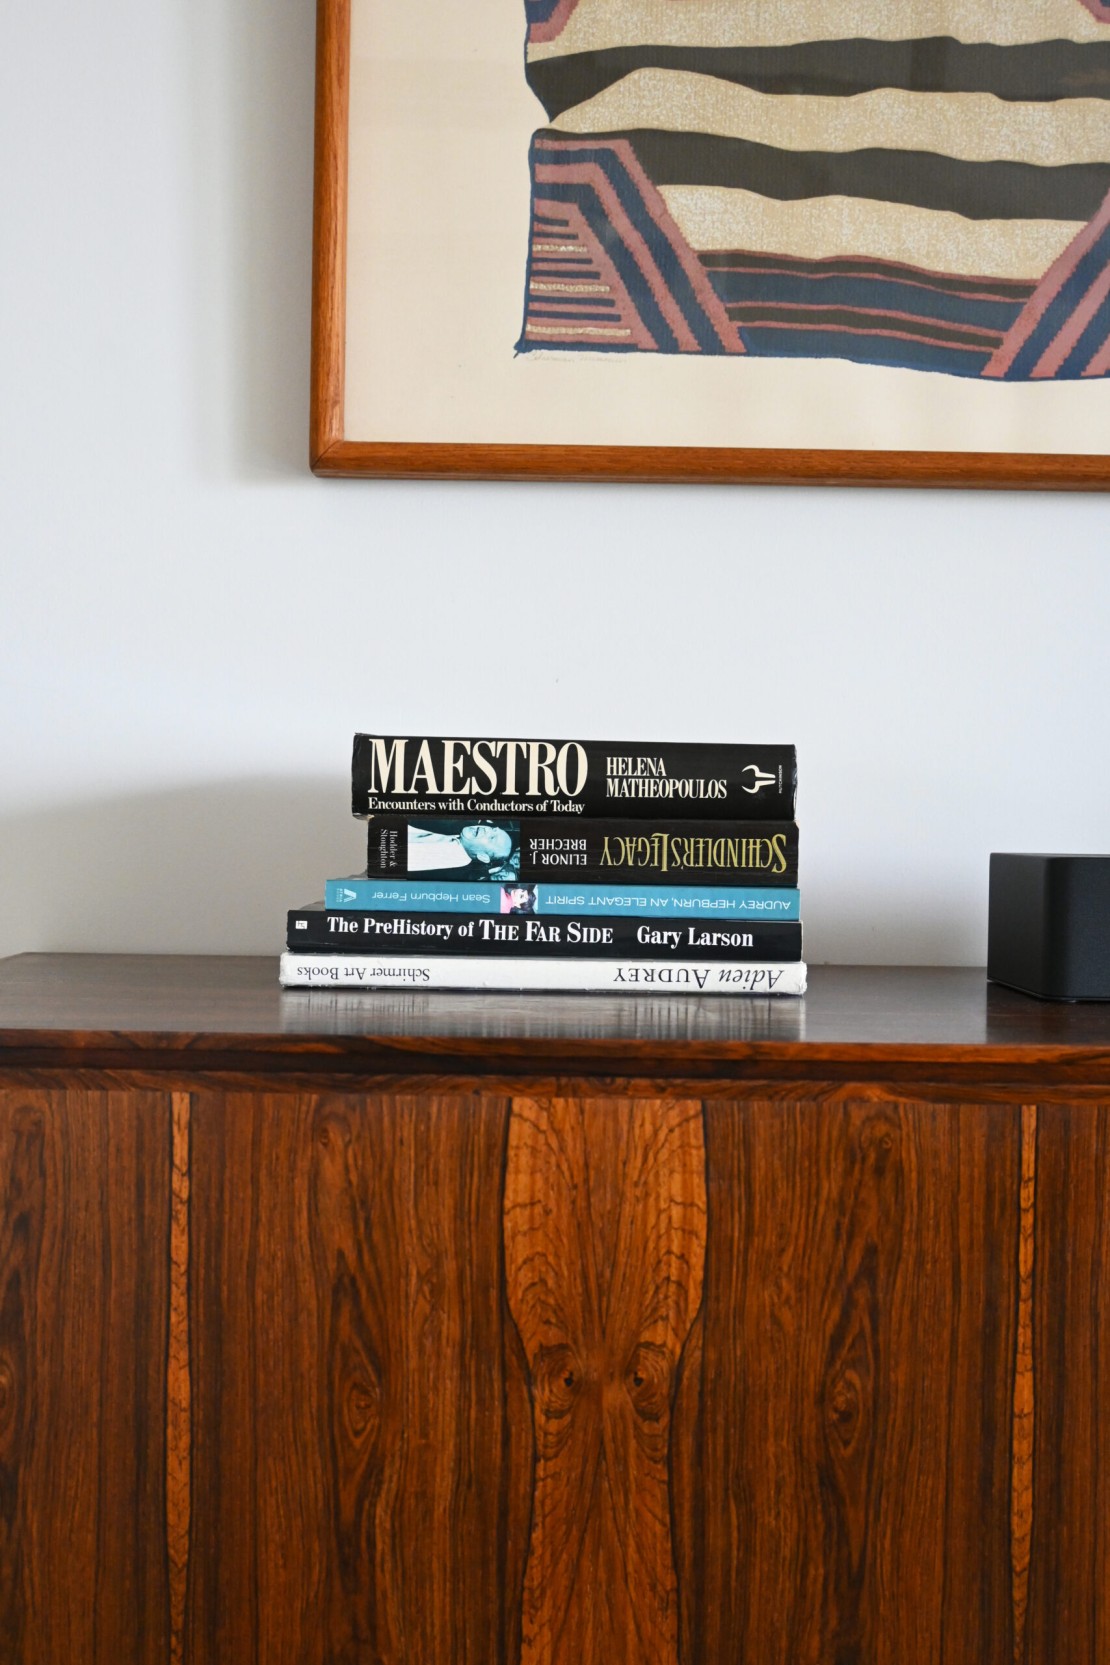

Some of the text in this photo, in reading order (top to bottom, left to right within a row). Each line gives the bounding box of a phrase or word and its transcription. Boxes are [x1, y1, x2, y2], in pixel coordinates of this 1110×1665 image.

[368, 738, 588, 797] MAESTRO
[606, 757, 667, 777] HELENA
[606, 778, 727, 799] MATHEOPOULOS
[368, 796, 585, 814] Encounters with Conductors of Today
[378, 828, 388, 869] Stoughton
[389, 830, 398, 859] Hodder
[529, 838, 587, 851] BRECHER
[600, 833, 670, 872] LEGACY
[529, 850, 587, 866] ELINOR J.
[371, 889, 491, 903] Sean Hepburn Ferrer
[545, 895, 791, 910] AUDREY HEPBURN, AN ELEGANT SPIRIT
[327, 916, 359, 933] The
[363, 917, 453, 940] PreHistory
[458, 920, 476, 937] of
[478, 919, 519, 941] THE
[524, 920, 561, 942] FAR
[566, 921, 613, 944] SIDE
[637, 925, 754, 949] Gary Larson
[297, 966, 430, 981] Schirmer Art Books
[613, 967, 784, 990] Adieu AUDREY
